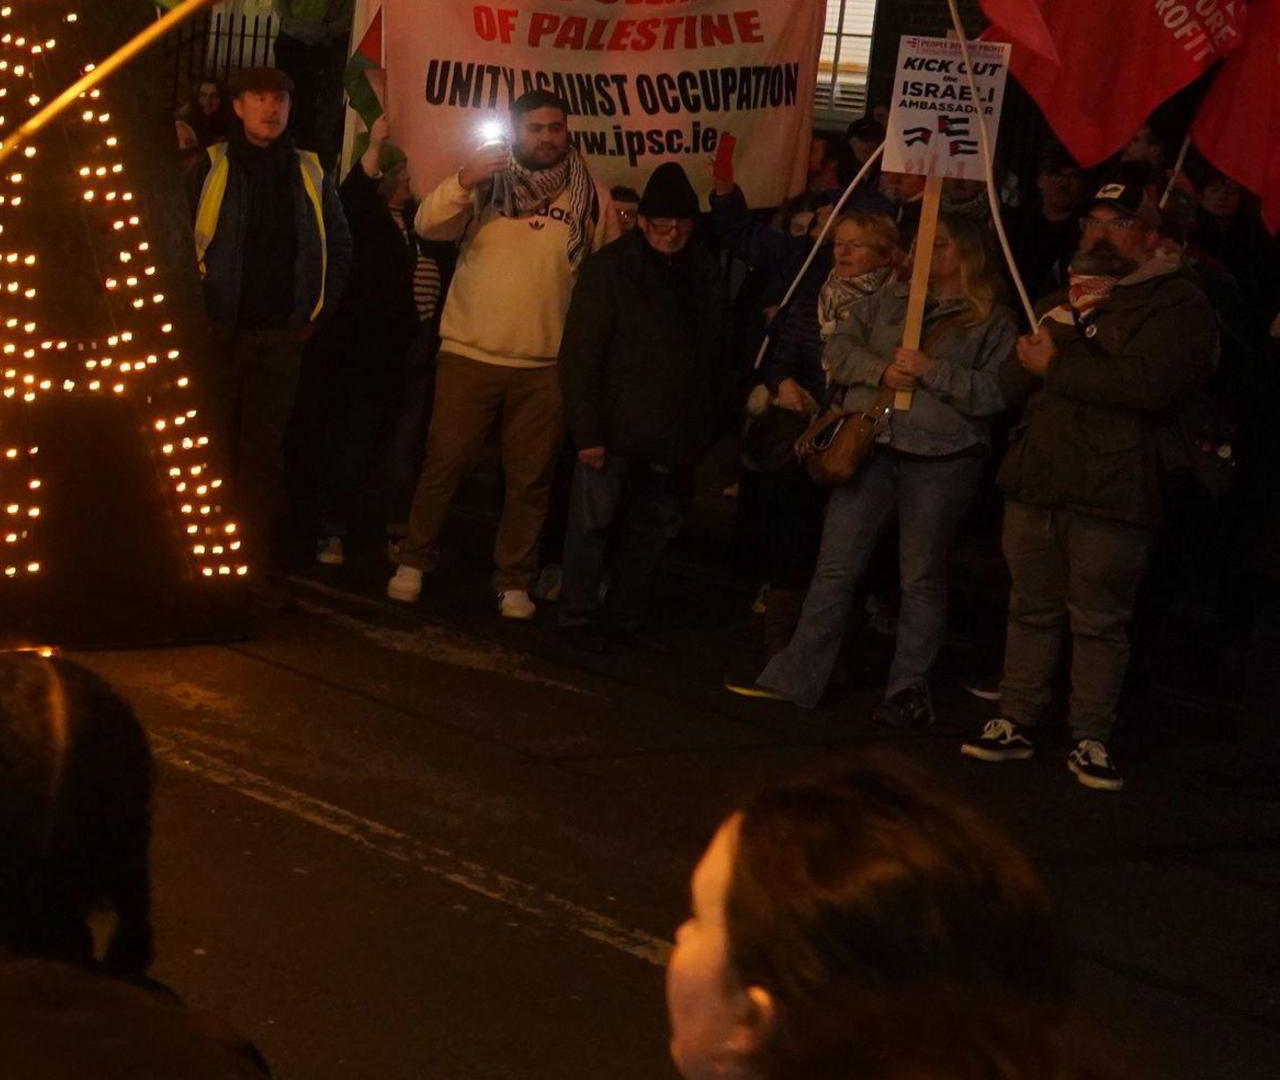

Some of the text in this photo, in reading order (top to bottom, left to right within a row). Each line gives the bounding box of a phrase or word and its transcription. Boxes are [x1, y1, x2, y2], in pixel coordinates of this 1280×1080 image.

[472, 5, 765, 52] OF PALESTINE
[903, 57, 954, 73] KICK
[426, 59, 515, 110] UNITY
[637, 63, 799, 116] OCCUPATION
[898, 99, 994, 116] AMBASSADR
